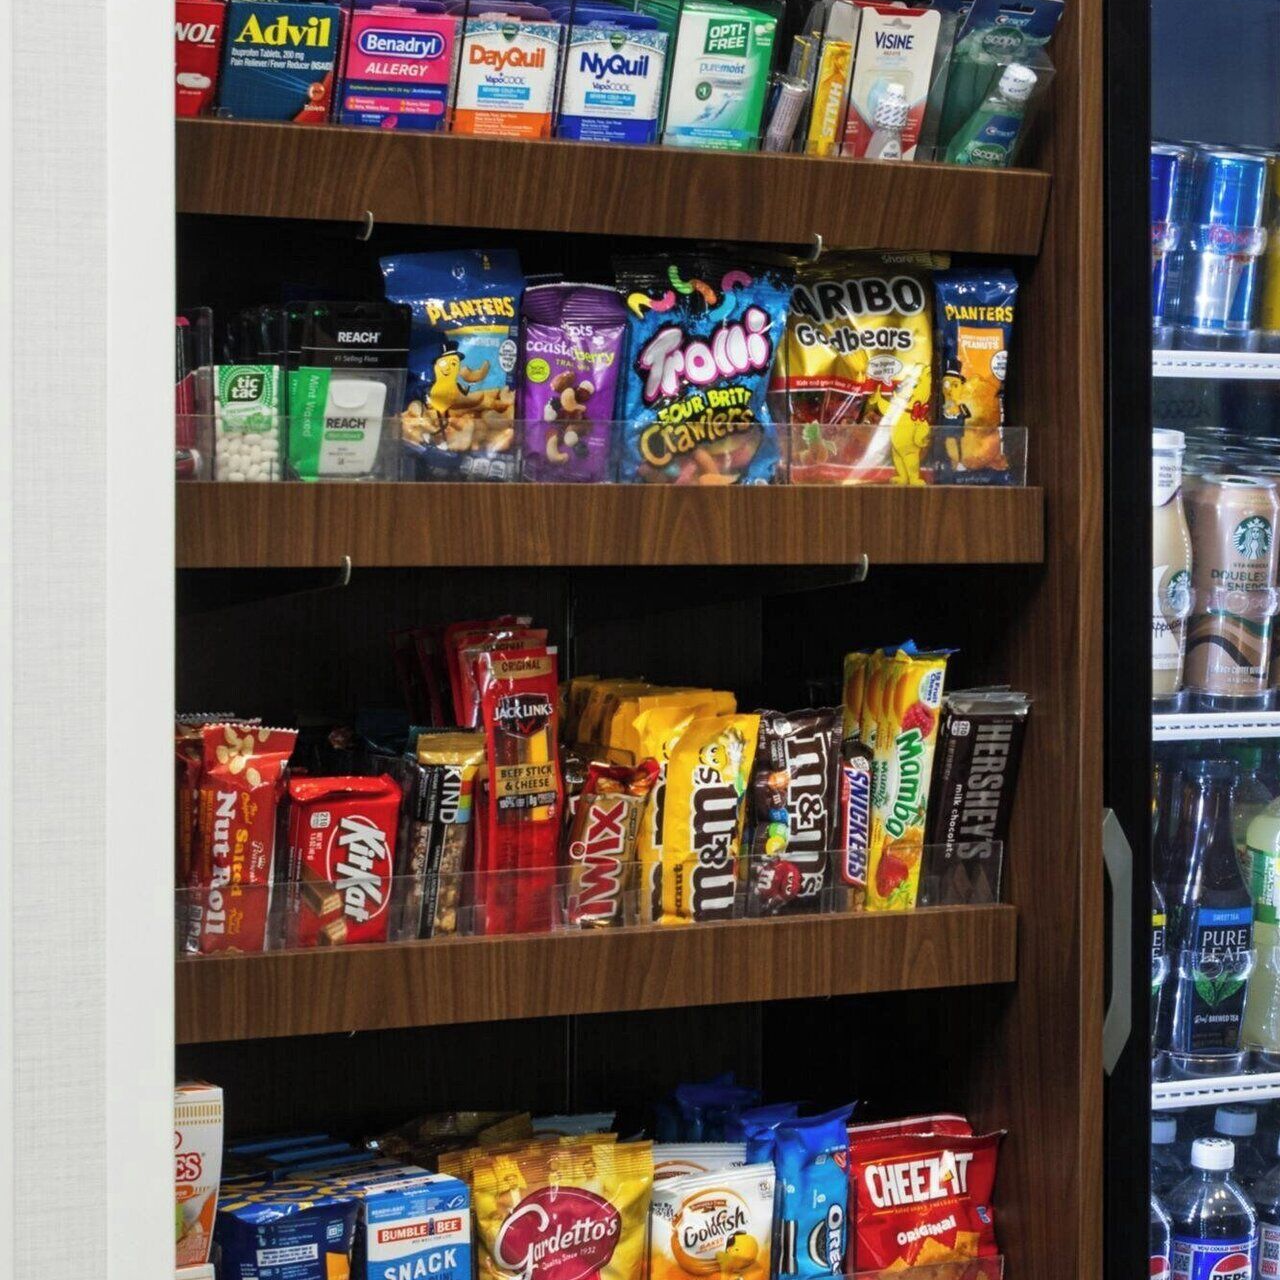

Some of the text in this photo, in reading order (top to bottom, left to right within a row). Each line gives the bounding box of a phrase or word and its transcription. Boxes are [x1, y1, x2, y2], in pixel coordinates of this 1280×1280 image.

[234, 13, 333, 47] Advil
[709, 23, 746, 39] OPTI-
[874, 31, 915, 50] VISINE
[366, 34, 436, 57] Benadryl
[708, 35, 746, 52] FREE
[983, 32, 1022, 50] scope
[230, 57, 243, 66] Pain
[468, 44, 546, 71] DayQuil
[579, 51, 650, 80] NyQuil
[365, 62, 429, 76] ALLERGY
[821, 81, 844, 138] HALLS
[971, 148, 1005, 162] scope
[425, 296, 515, 326] PLANTERS
[944, 305, 1015, 323] PLANTERS
[337, 331, 380, 343] REACH
[342, 355, 364, 364] Selling
[640, 307, 769, 402] Trolli
[236, 374, 259, 389] tic
[309, 374, 320, 403] Mint
[231, 386, 259, 399] tac
[657, 396, 706, 426] SOUR
[325, 417, 367, 429] REACH
[640, 407, 754, 467] Crawlers
[492, 705, 522, 721] JACK
[500, 765, 553, 779] BEEF STICK
[504, 778, 550, 791] & CHEESE
[885, 728, 925, 839] Mamba
[439, 765, 462, 825] KIND
[844, 765, 871, 883] SNICKERS
[945, 783, 963, 858] milk chocolate
[204, 789, 238, 935] Nut Roll
[230, 828, 249, 897] Salted
[1202, 929, 1247, 947] PURE
[381, 1222, 428, 1243] BUMBLE
[436, 1219, 458, 1234] BEE
[683, 1206, 746, 1249] Goldfish
[579, 1245, 597, 1257] 1932
